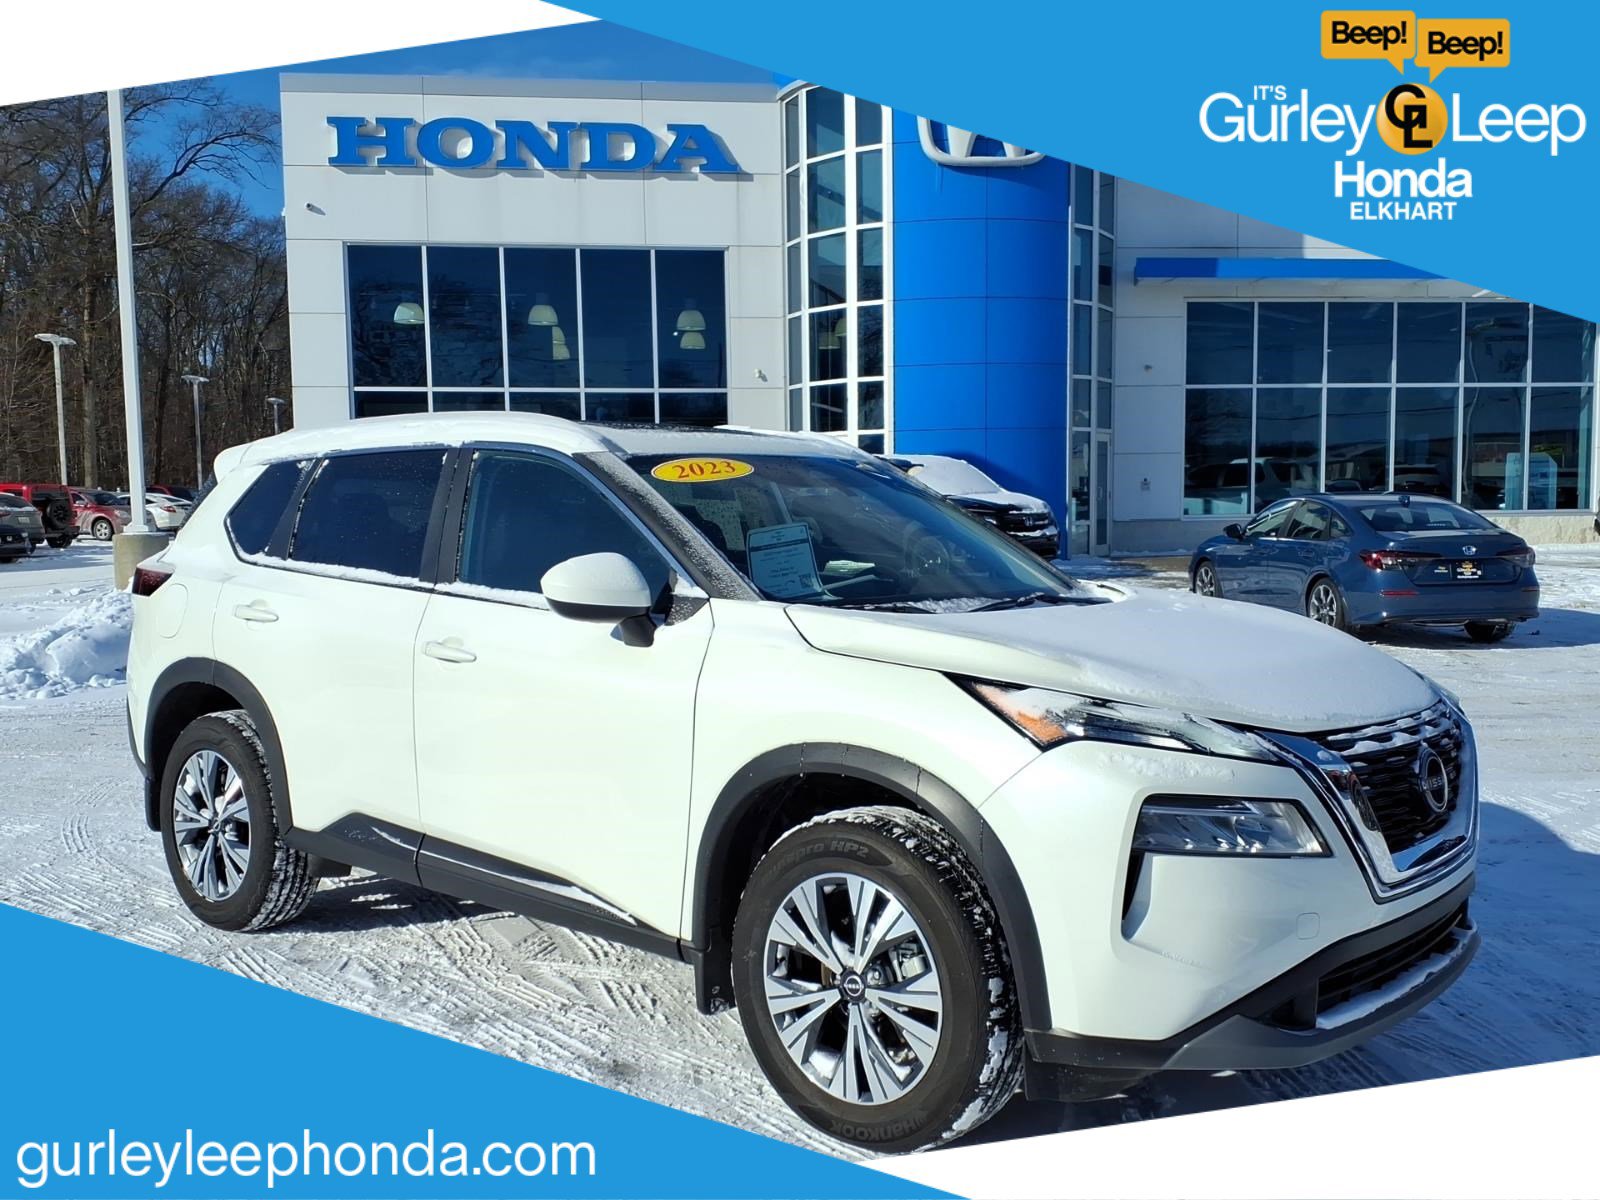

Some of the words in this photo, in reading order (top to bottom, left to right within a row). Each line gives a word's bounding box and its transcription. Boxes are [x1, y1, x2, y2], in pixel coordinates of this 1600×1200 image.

[327, 116, 740, 172] HONDA
[672, 461, 736, 479] 2023
[830, 840, 869, 858] HP2
